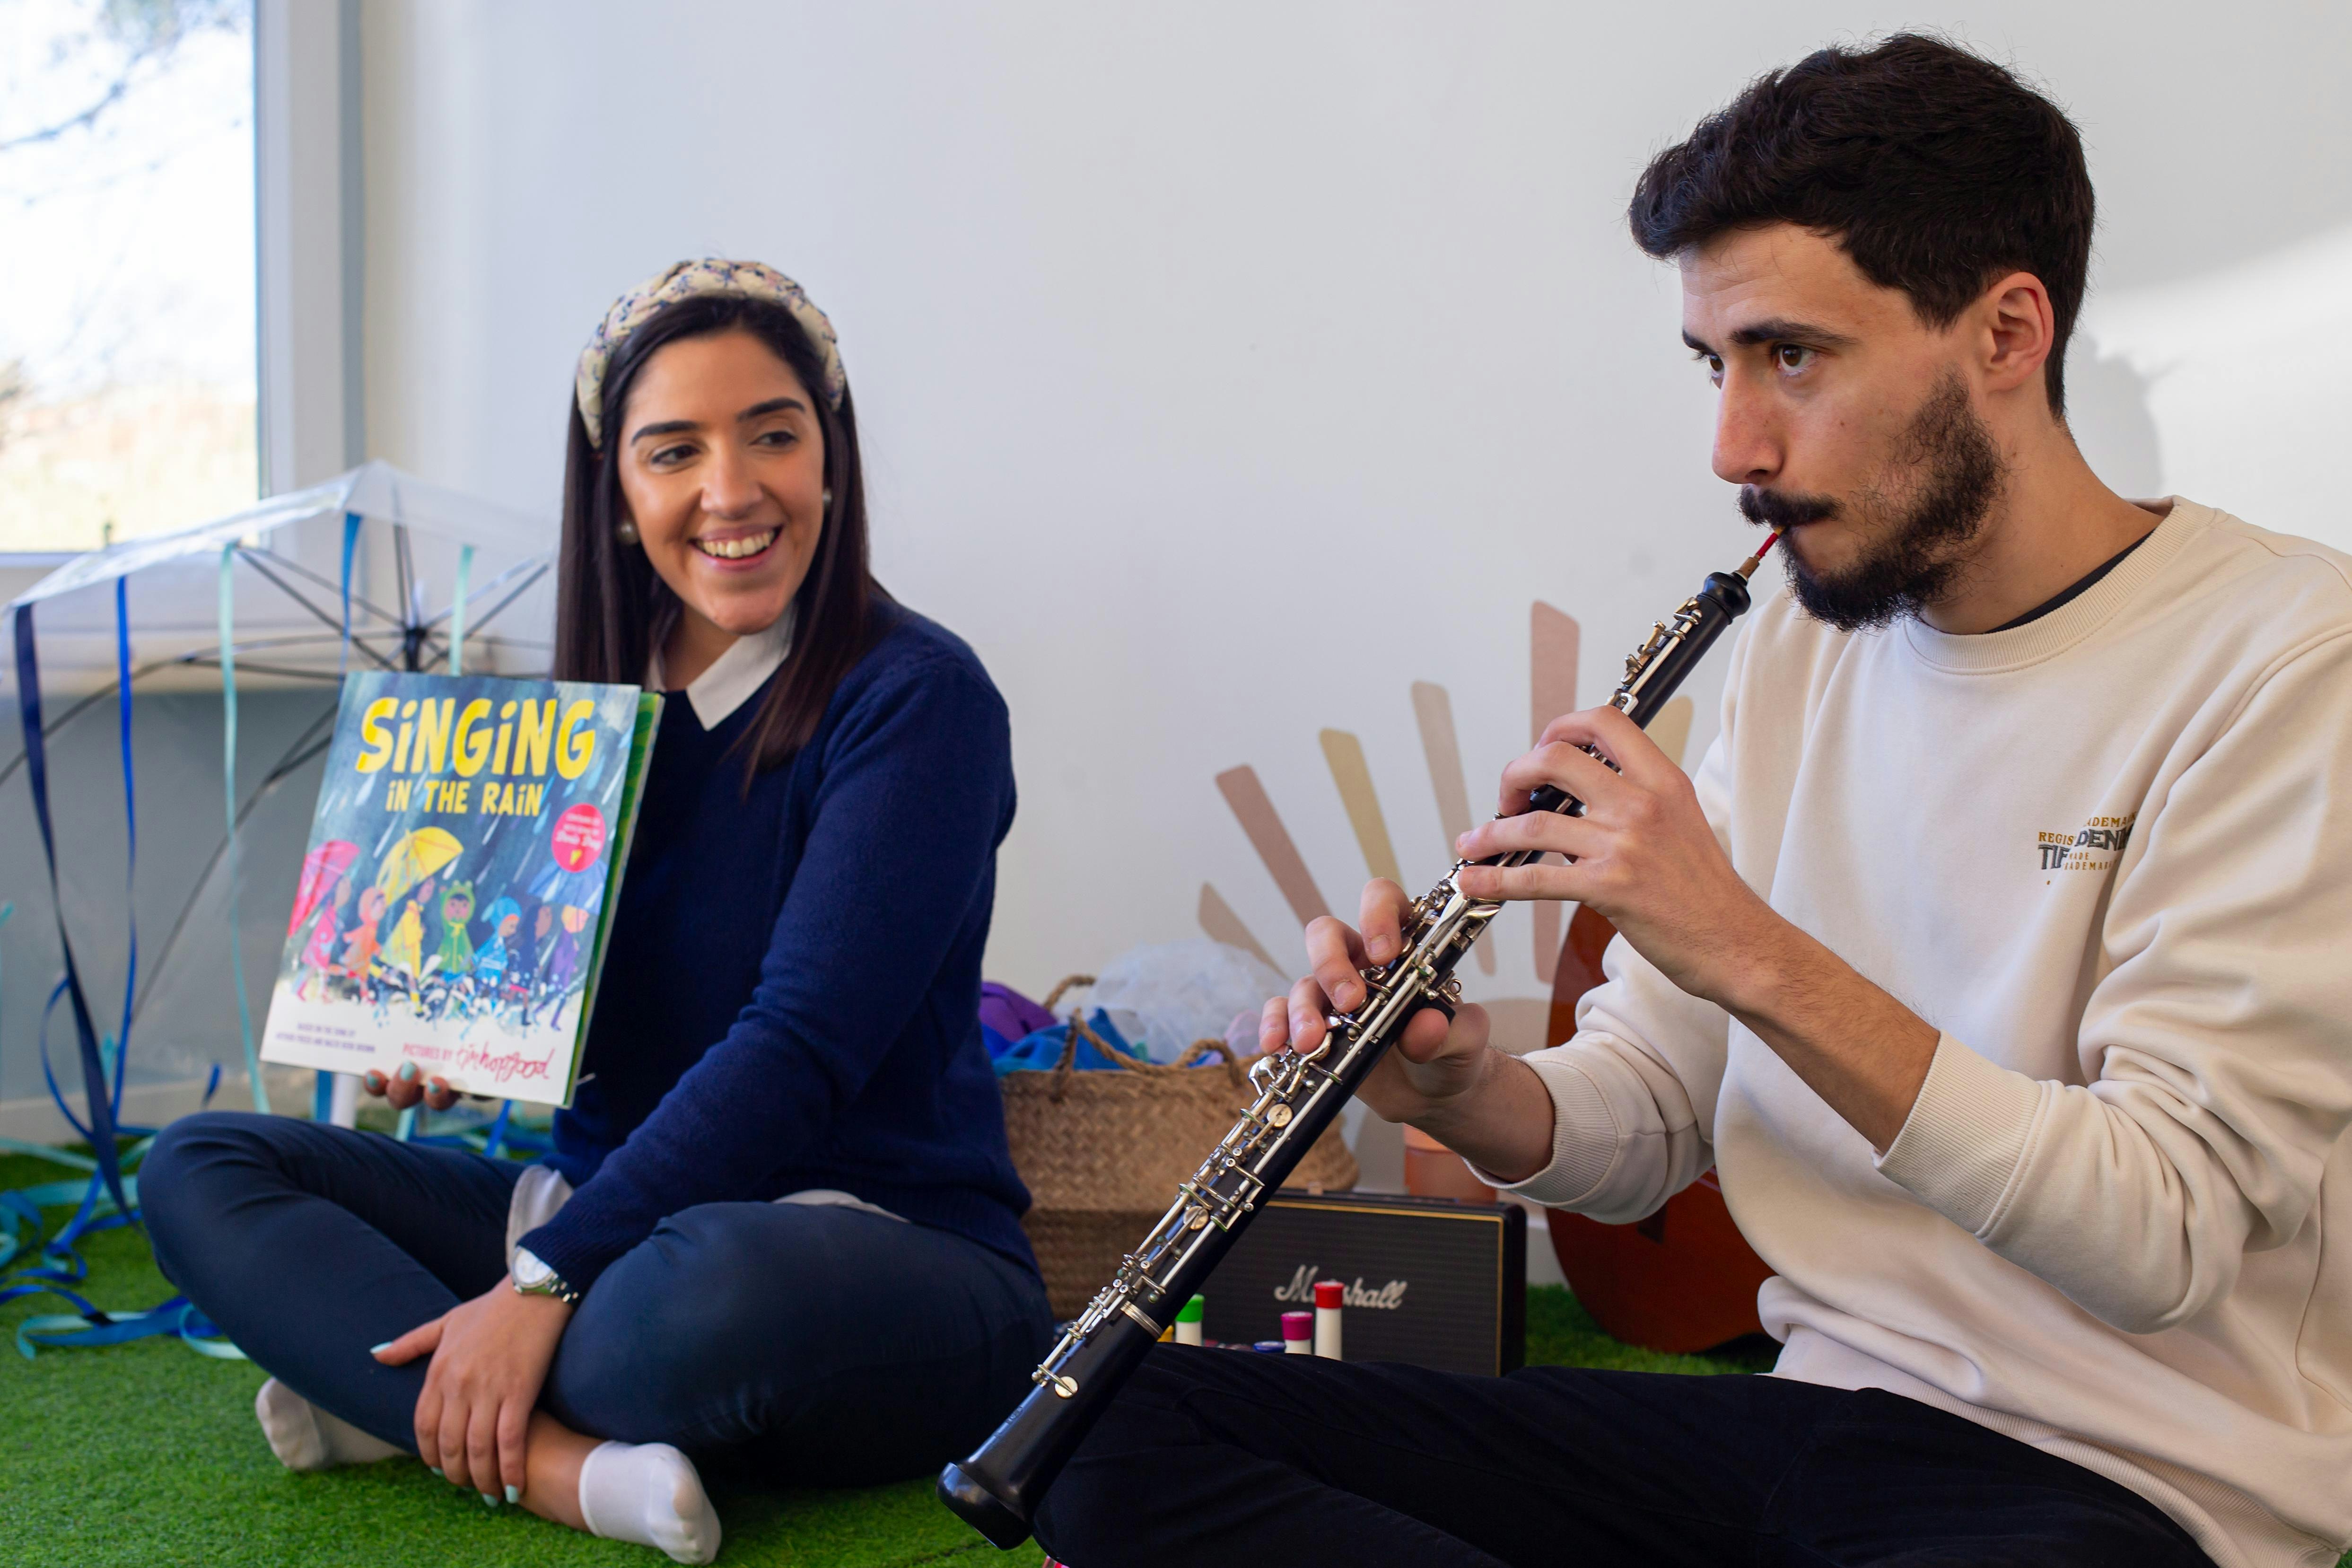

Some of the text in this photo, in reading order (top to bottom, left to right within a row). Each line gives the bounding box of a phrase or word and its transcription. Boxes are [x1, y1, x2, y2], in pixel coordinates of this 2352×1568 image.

[424, 780, 470, 814] THE
[2038, 832, 2075, 846] REGIS
[1274, 1264, 1408, 1310] Mshall
